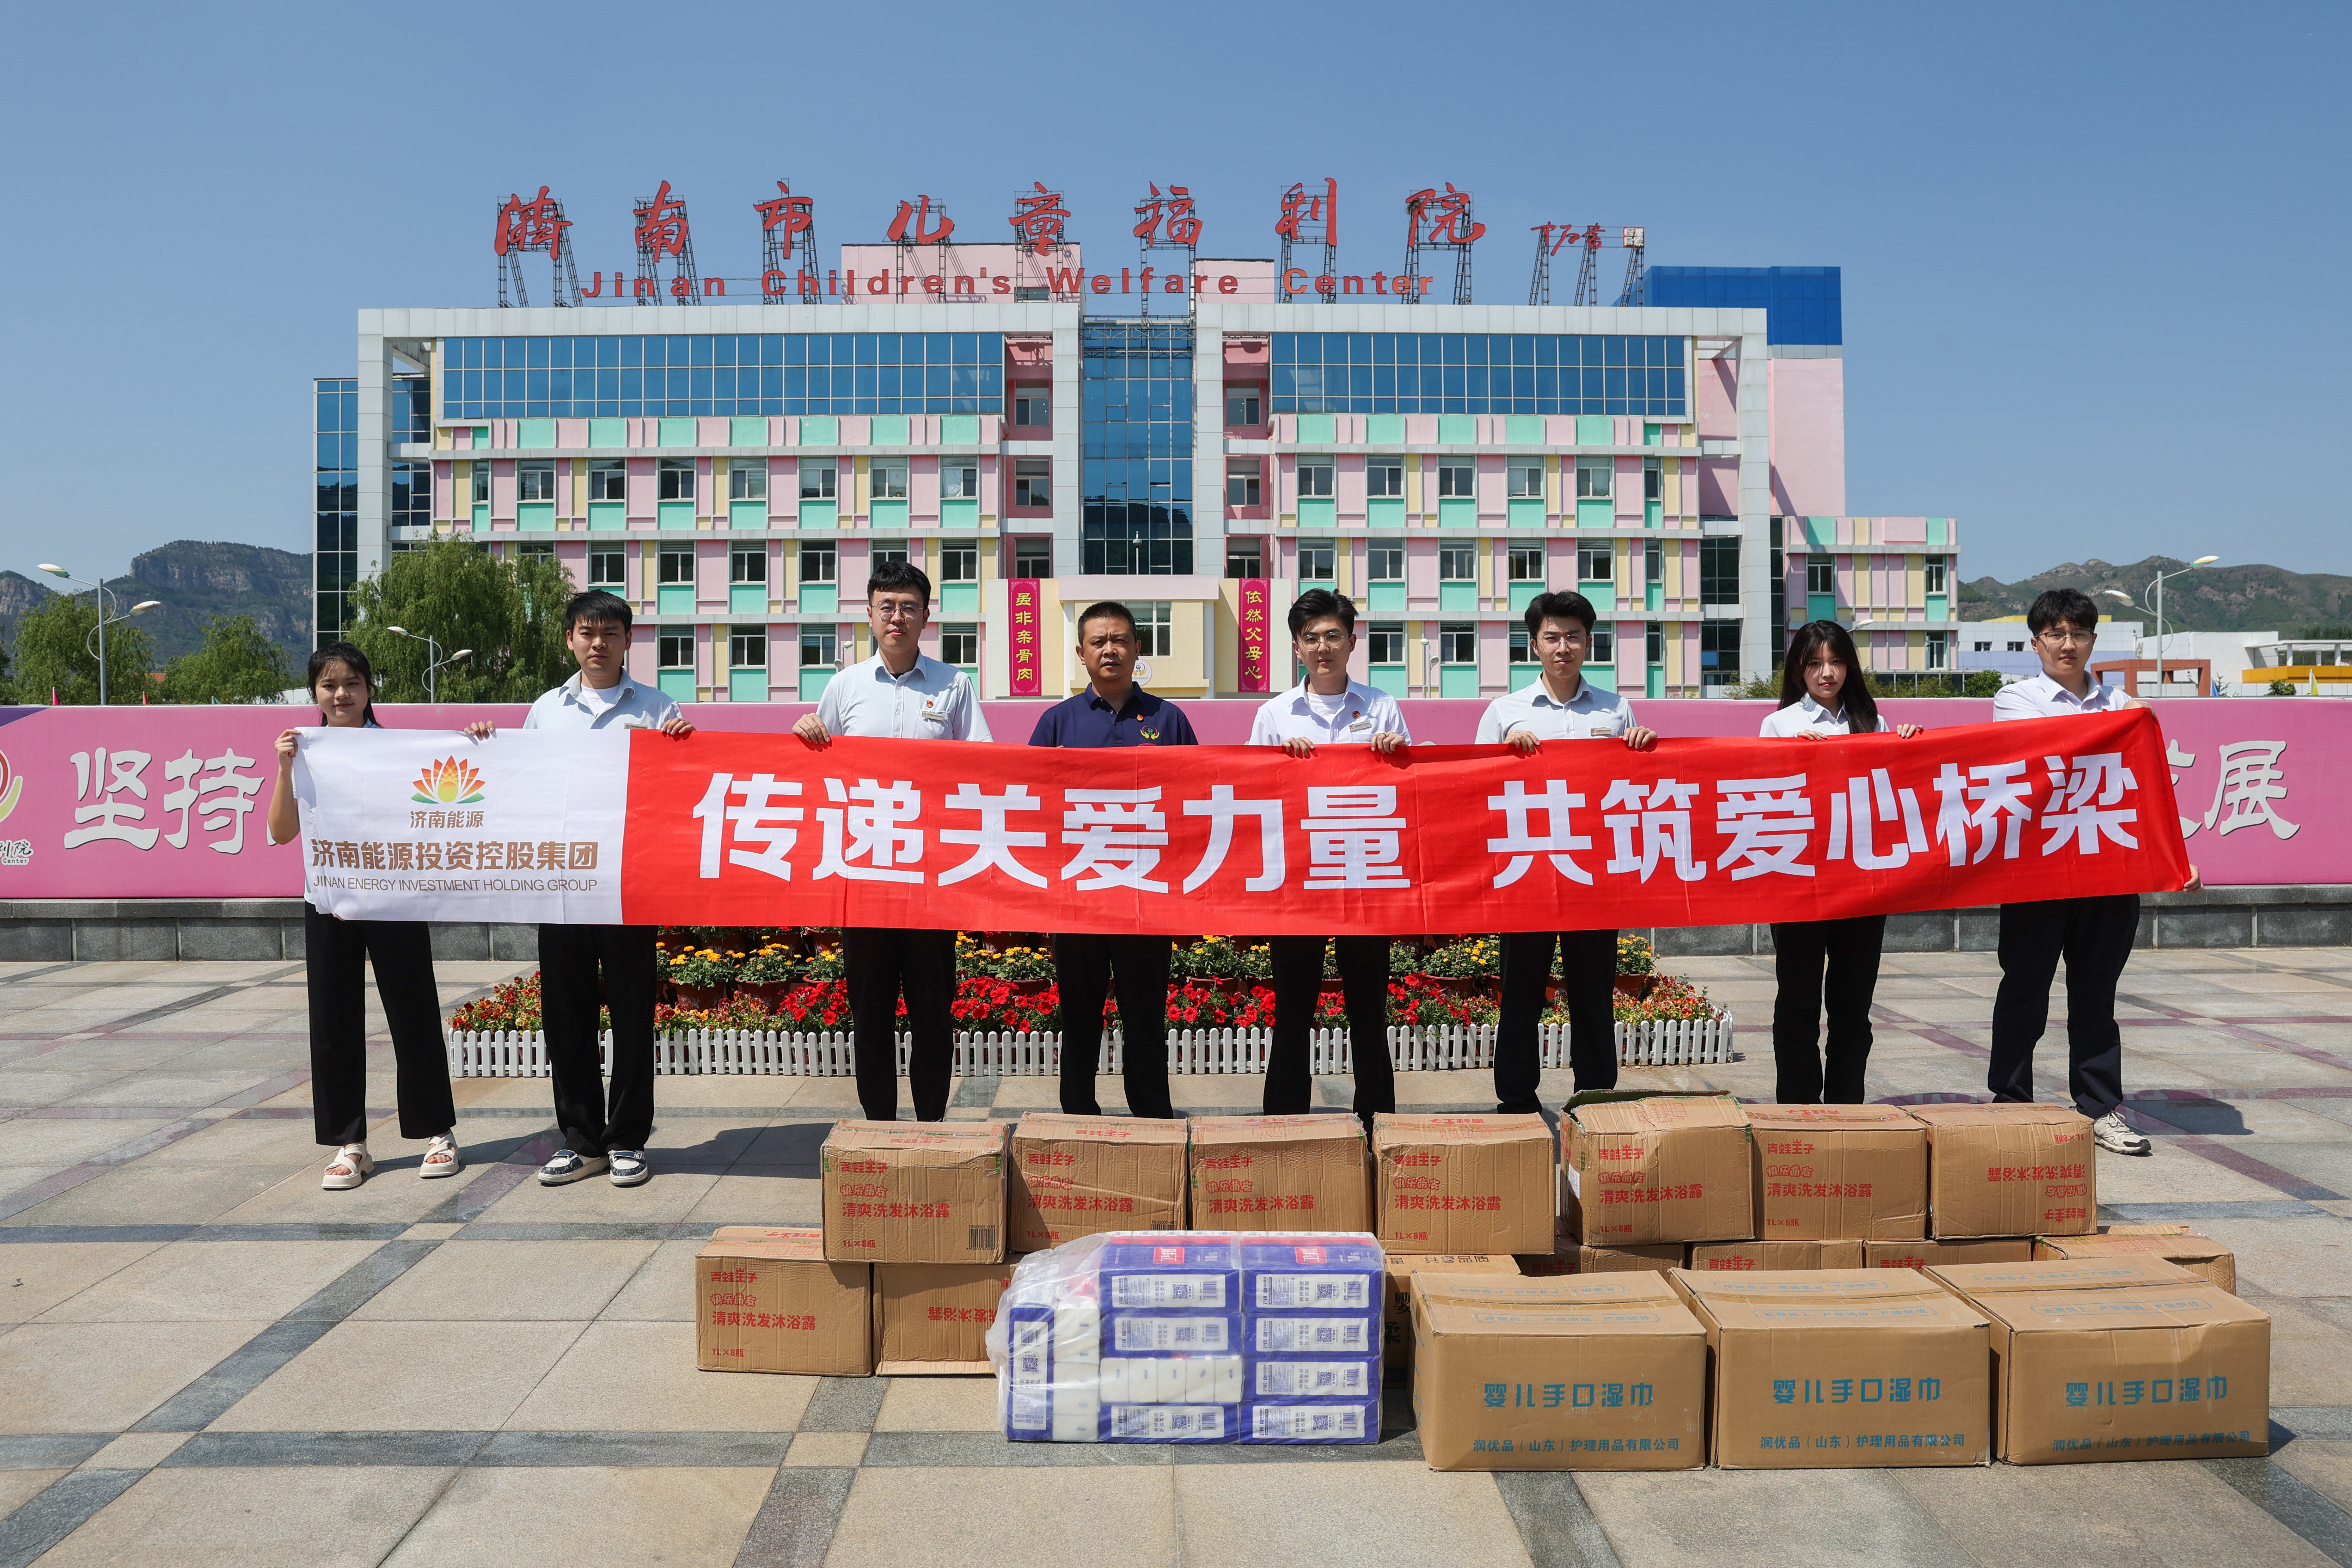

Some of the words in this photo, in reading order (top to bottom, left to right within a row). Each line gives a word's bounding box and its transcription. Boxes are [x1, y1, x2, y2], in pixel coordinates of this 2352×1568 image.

[581, 272, 725, 297] Jinan
[762, 267, 1011, 295] Children's
[1045, 267, 1238, 294] Welfare
[1284, 268, 1433, 294] Center
[1016, 592, 1033, 681] 虽非亲骨肉
[1245, 591, 1264, 680] 依然父母心
[64, 747, 277, 854] 坚持
[410, 810, 484, 829] 济南能源
[692, 772, 1410, 895] 传递关爱力量
[1486, 750, 2139, 890] 共筑爱心桥梁
[311, 838, 598, 871] 济南能源投资控股集团
[314, 876, 345, 889] JINAN
[348, 878, 396, 891] ENERGY
[400, 879, 481, 891] INVESTMENT
[484, 879, 545, 891] HOLDING
[548, 879, 597, 891] GROUP
[1599, 1148, 1644, 1161] 青蛙王子
[1767, 1143, 1814, 1155] 青蛙王子
[1028, 1154, 1075, 1166] 青蛙王子
[1206, 1158, 1253, 1169] 青蛙王子
[1394, 1155, 1441, 1167] 青蛙王子
[841, 1162, 888, 1174] 青蛙王子
[1766, 1164, 1813, 1178] 快乐萌友
[1988, 1167, 2086, 1182] 清爽洗发沐浴露
[1026, 1176, 1073, 1190] 快乐萌友
[1393, 1177, 1440, 1190] 快乐萌友
[1598, 1171, 1645, 1184] 快乐萌友
[840, 1184, 888, 1198] 快乐萌友
[1206, 1179, 1253, 1194] 快乐萌友
[1767, 1183, 1872, 1197] 清爽洗发沐浴露
[1600, 1184, 1703, 1204] 清爽洗发沐浴露
[1028, 1194, 1133, 1213] 清爽洗发沐浴露
[1209, 1195, 1314, 1213] 清爽洗发沐浴露
[1394, 1195, 1501, 1211] 清爽洗发沐浴露
[842, 1203, 950, 1219] 清爽洗发沐浴露
[2044, 1207, 2086, 1219] 青蛙王子
[1160, 1248, 1177, 1262] 卫邦
[1302, 1249, 1320, 1262] 卫邦
[1424, 1255, 1490, 1264] 共享品质
[1531, 1263, 1577, 1274] 青蛙王子
[1709, 1259, 1755, 1270] 青蛙王子
[1880, 1259, 1926, 1269] 青蛙王子
[710, 1272, 758, 1283] 青蛙王子
[710, 1293, 756, 1307] 快乐萌友
[712, 1311, 816, 1331] 清爽洗发沐浴露
[1484, 1382, 1653, 1408] 婴儿手口湿巾
[1773, 1377, 1940, 1404] 婴儿手口湿巾
[2066, 1376, 2227, 1407] 婴儿手口湿巾
